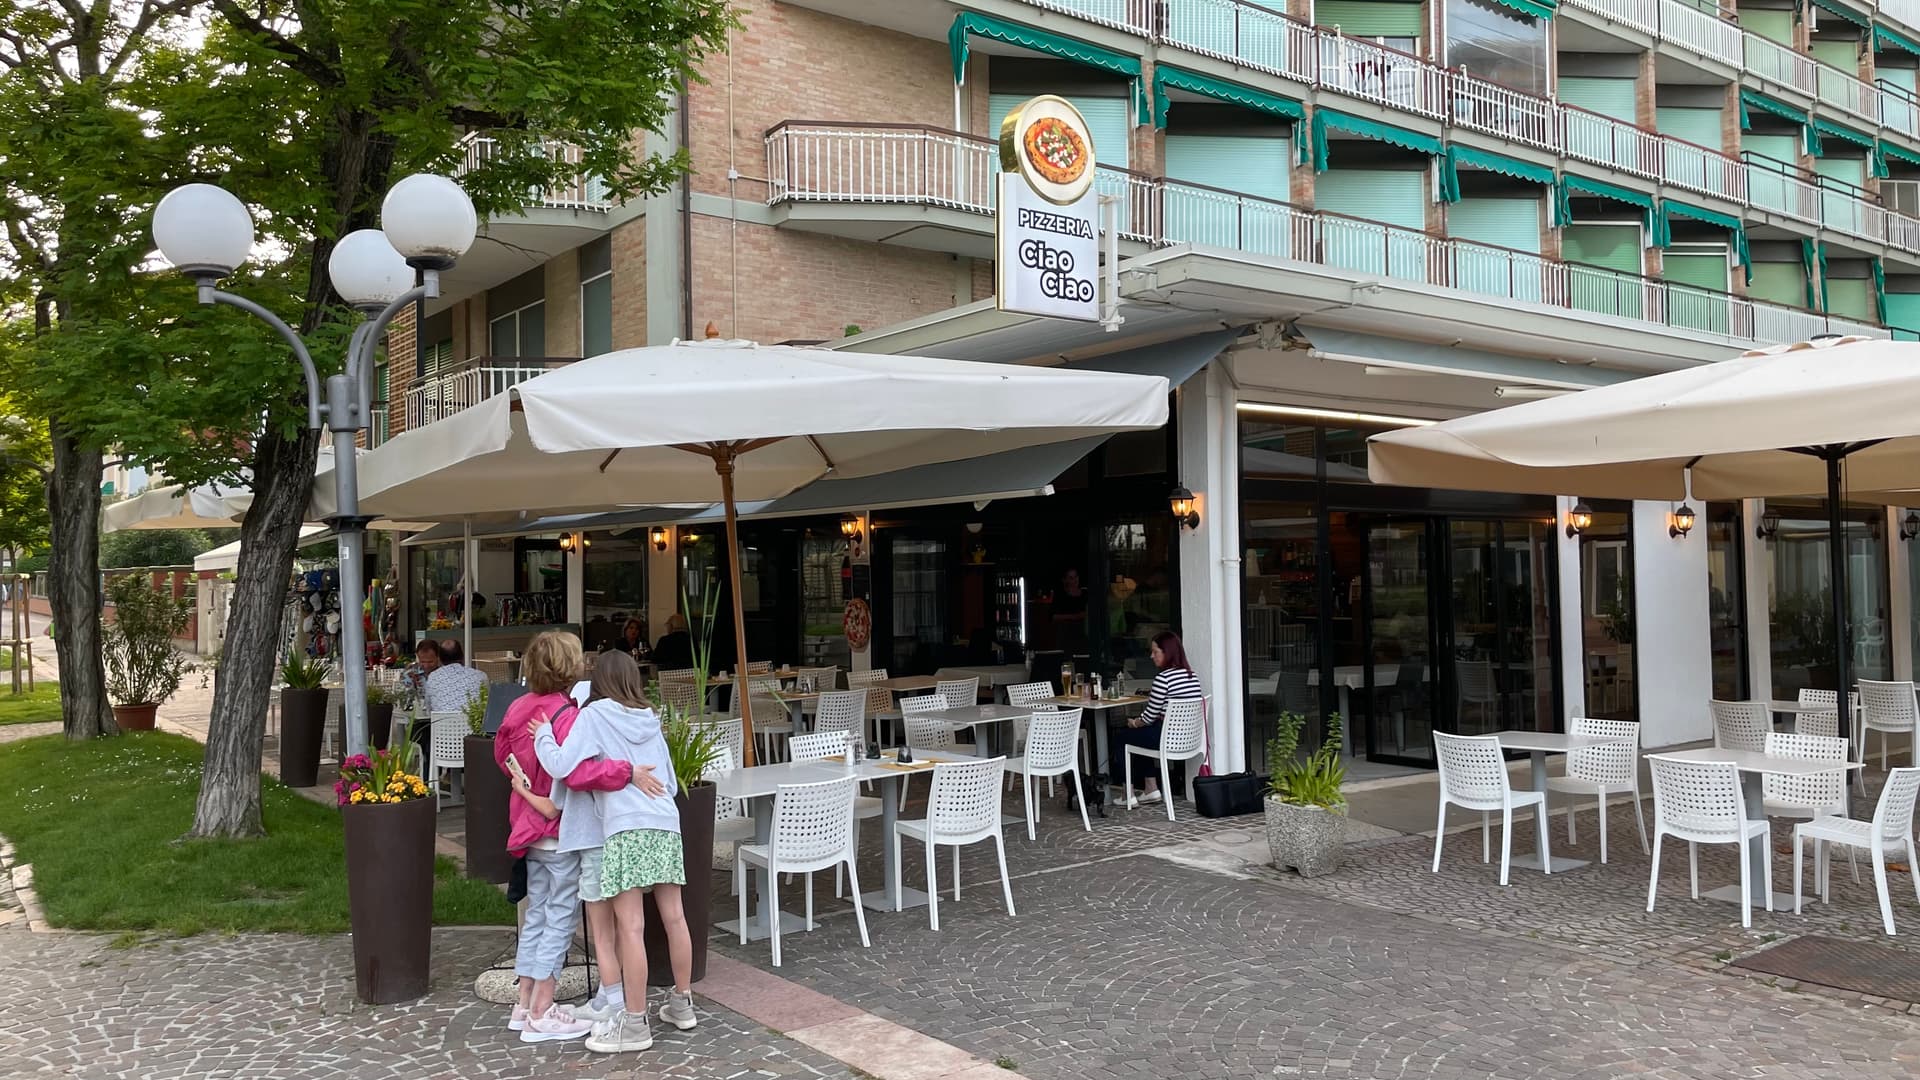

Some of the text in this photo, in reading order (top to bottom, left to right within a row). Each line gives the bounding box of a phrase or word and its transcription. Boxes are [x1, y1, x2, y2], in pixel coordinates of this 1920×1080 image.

[1018, 207, 1094, 240] PIZZERIA
[1019, 239, 1074, 273] Ciao
[1040, 268, 1095, 303] Ciao
